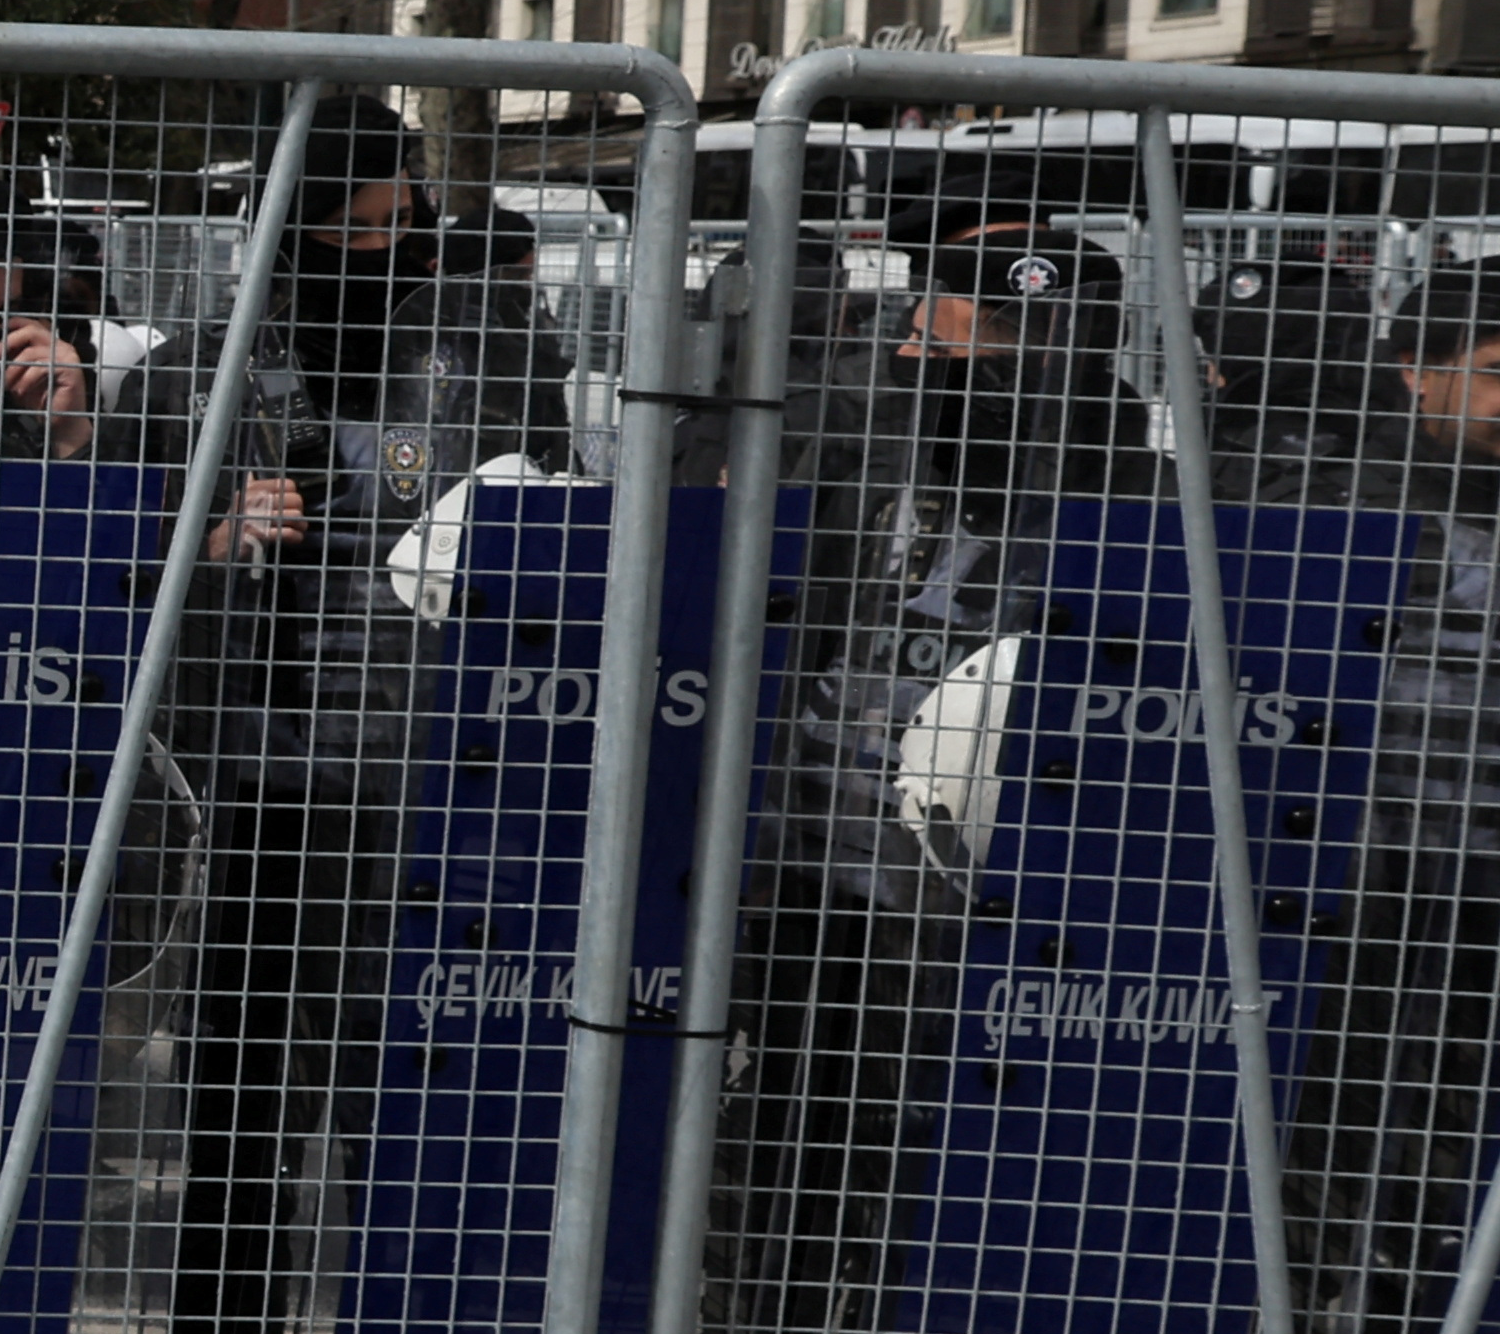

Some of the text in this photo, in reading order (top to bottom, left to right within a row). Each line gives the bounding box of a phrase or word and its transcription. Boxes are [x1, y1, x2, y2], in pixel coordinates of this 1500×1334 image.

[486, 656, 708, 726] POS
[416, 956, 537, 1029] ÇEVİK
[982, 975, 1104, 1051] ÇEVİK
